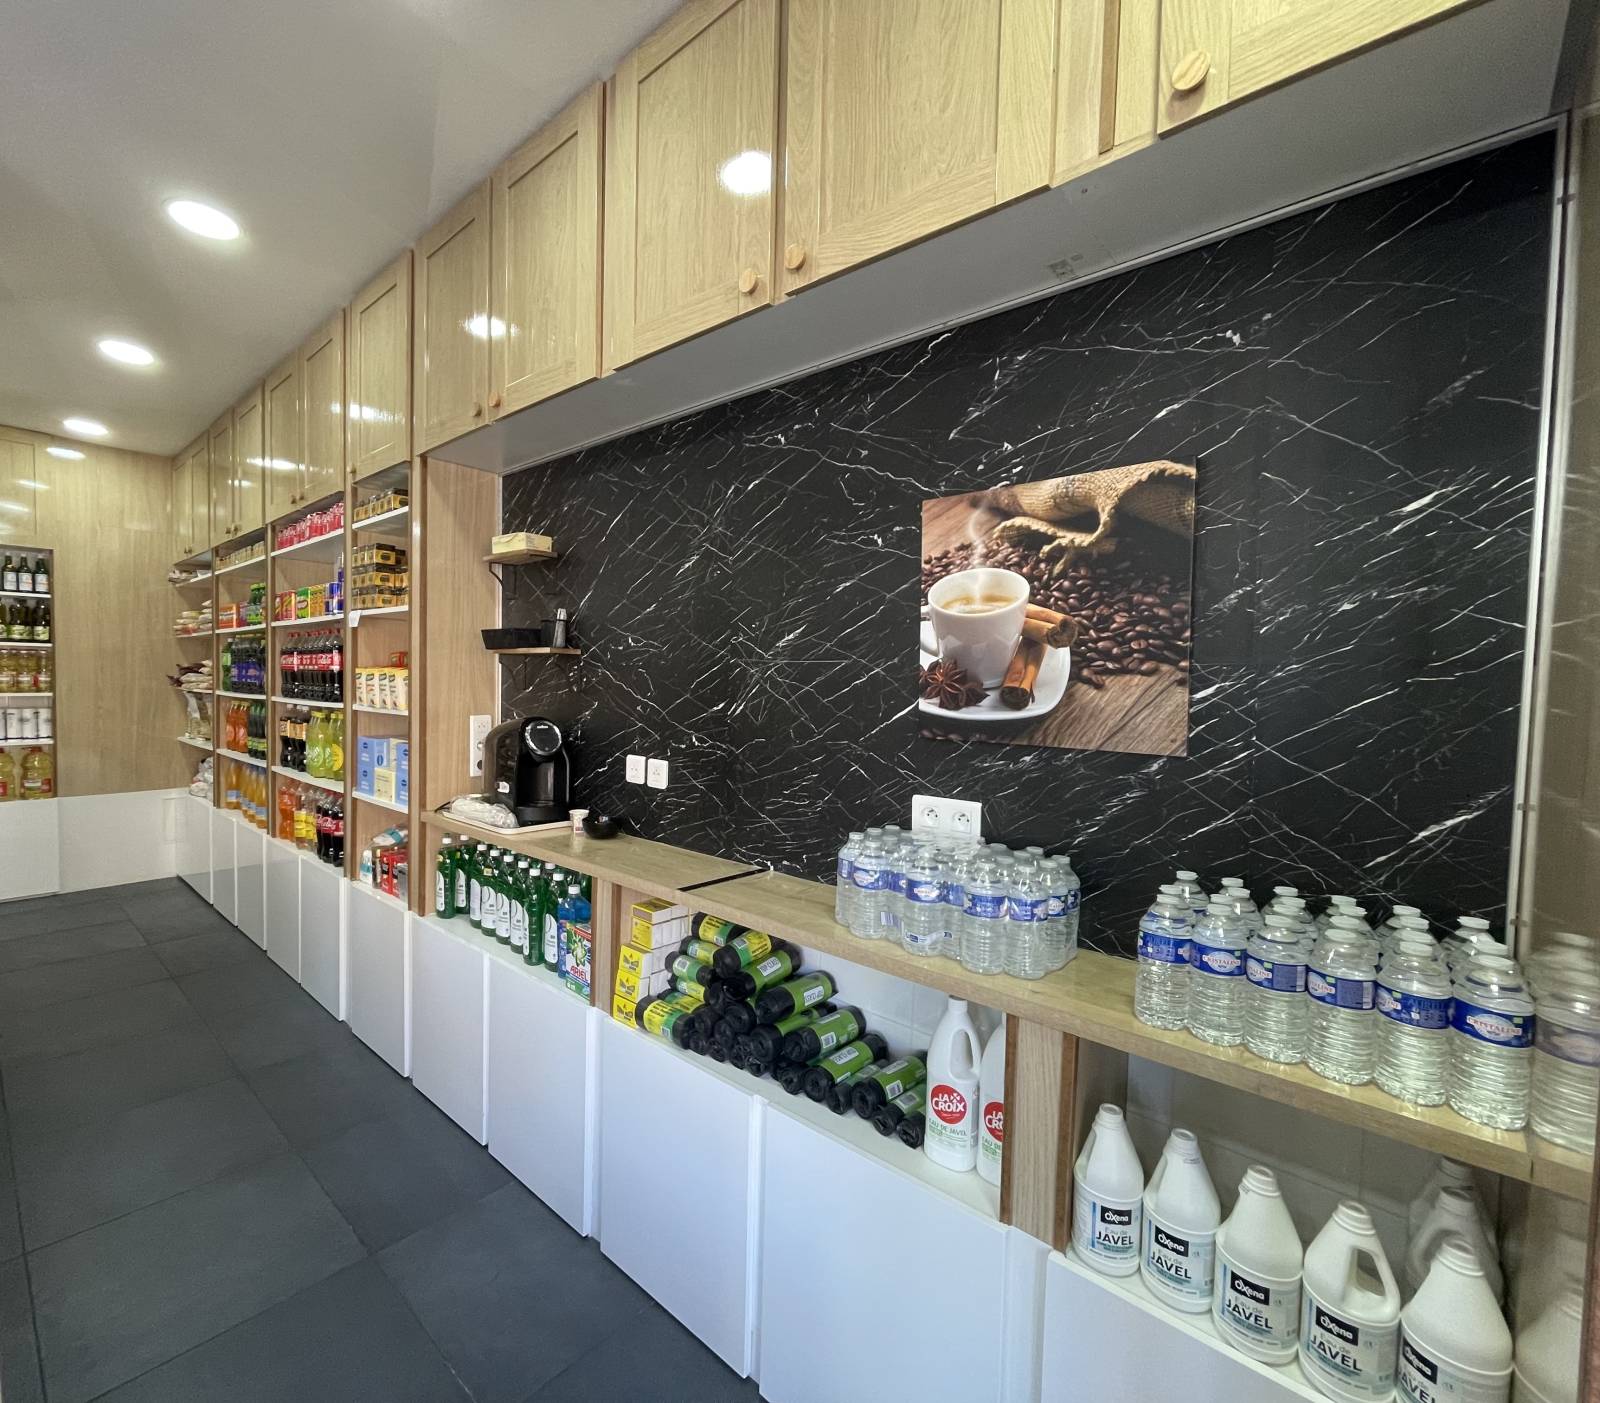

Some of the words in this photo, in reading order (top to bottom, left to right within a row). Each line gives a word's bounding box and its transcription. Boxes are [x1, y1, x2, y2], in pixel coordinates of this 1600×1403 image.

[570, 965, 588, 981] ARIEL
[1467, 1016, 1521, 1035] CRISTALINE
[932, 1097, 965, 1112] CROIX
[939, 1093, 949, 1101] LA
[1096, 1231, 1134, 1246] JAVEL
[1150, 1251, 1192, 1280] JAVEL
[1226, 1298, 1273, 1330] JAVEL
[1311, 1334, 1363, 1373] JAVEL
